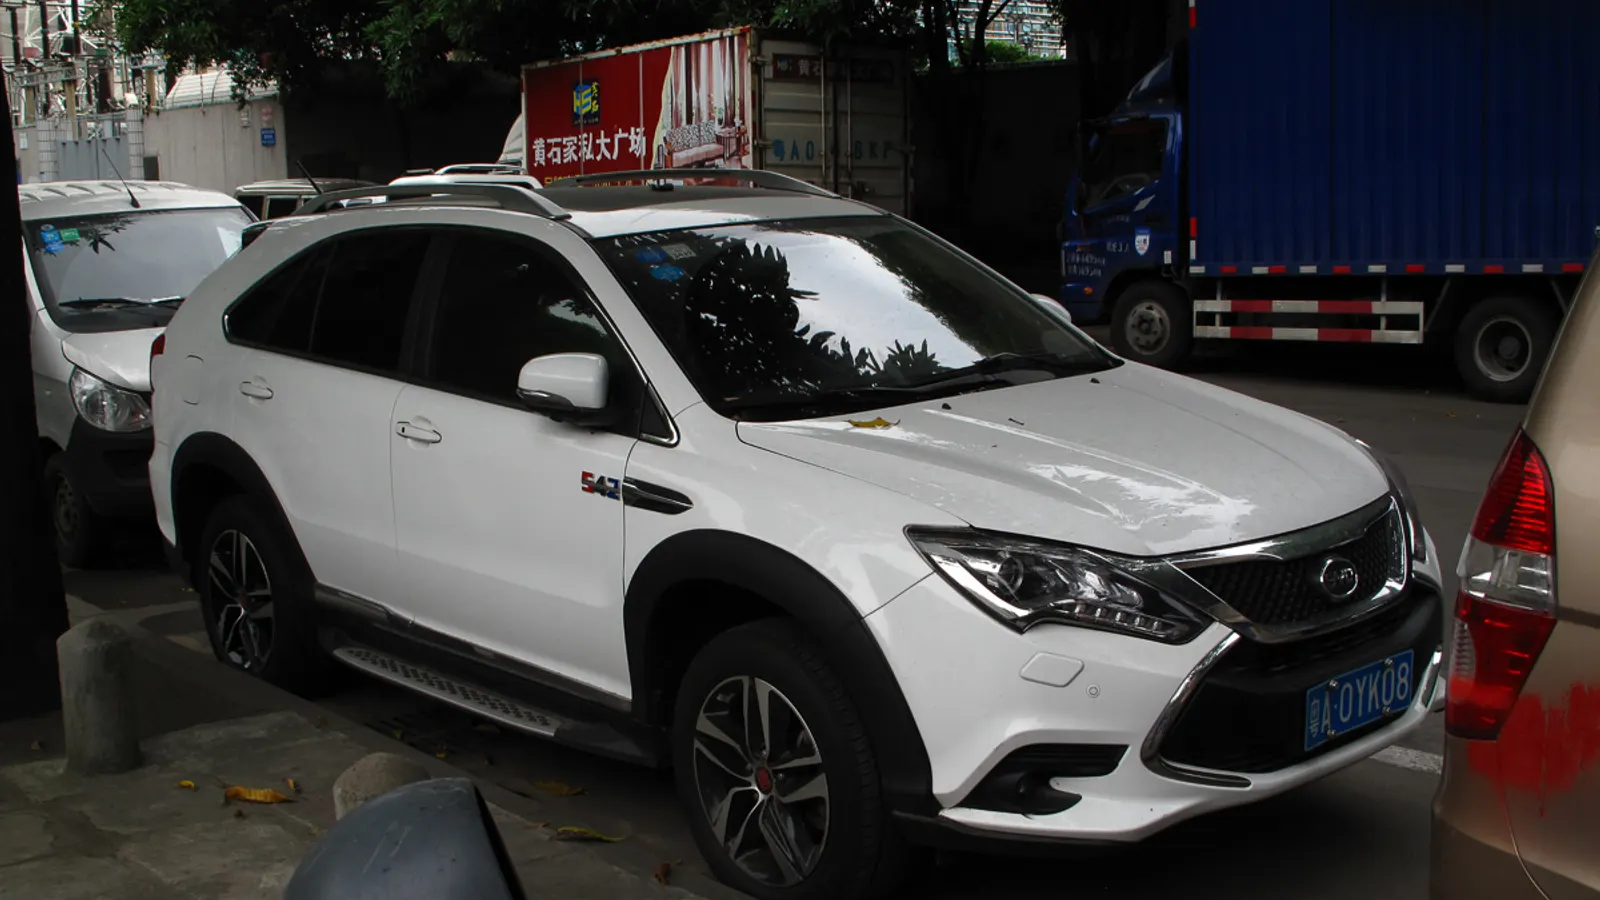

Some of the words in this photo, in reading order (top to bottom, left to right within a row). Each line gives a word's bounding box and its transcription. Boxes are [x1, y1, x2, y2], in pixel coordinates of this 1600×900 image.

[532, 126, 647, 167] 黄石家私大广场
[582, 471, 620, 500] 542
